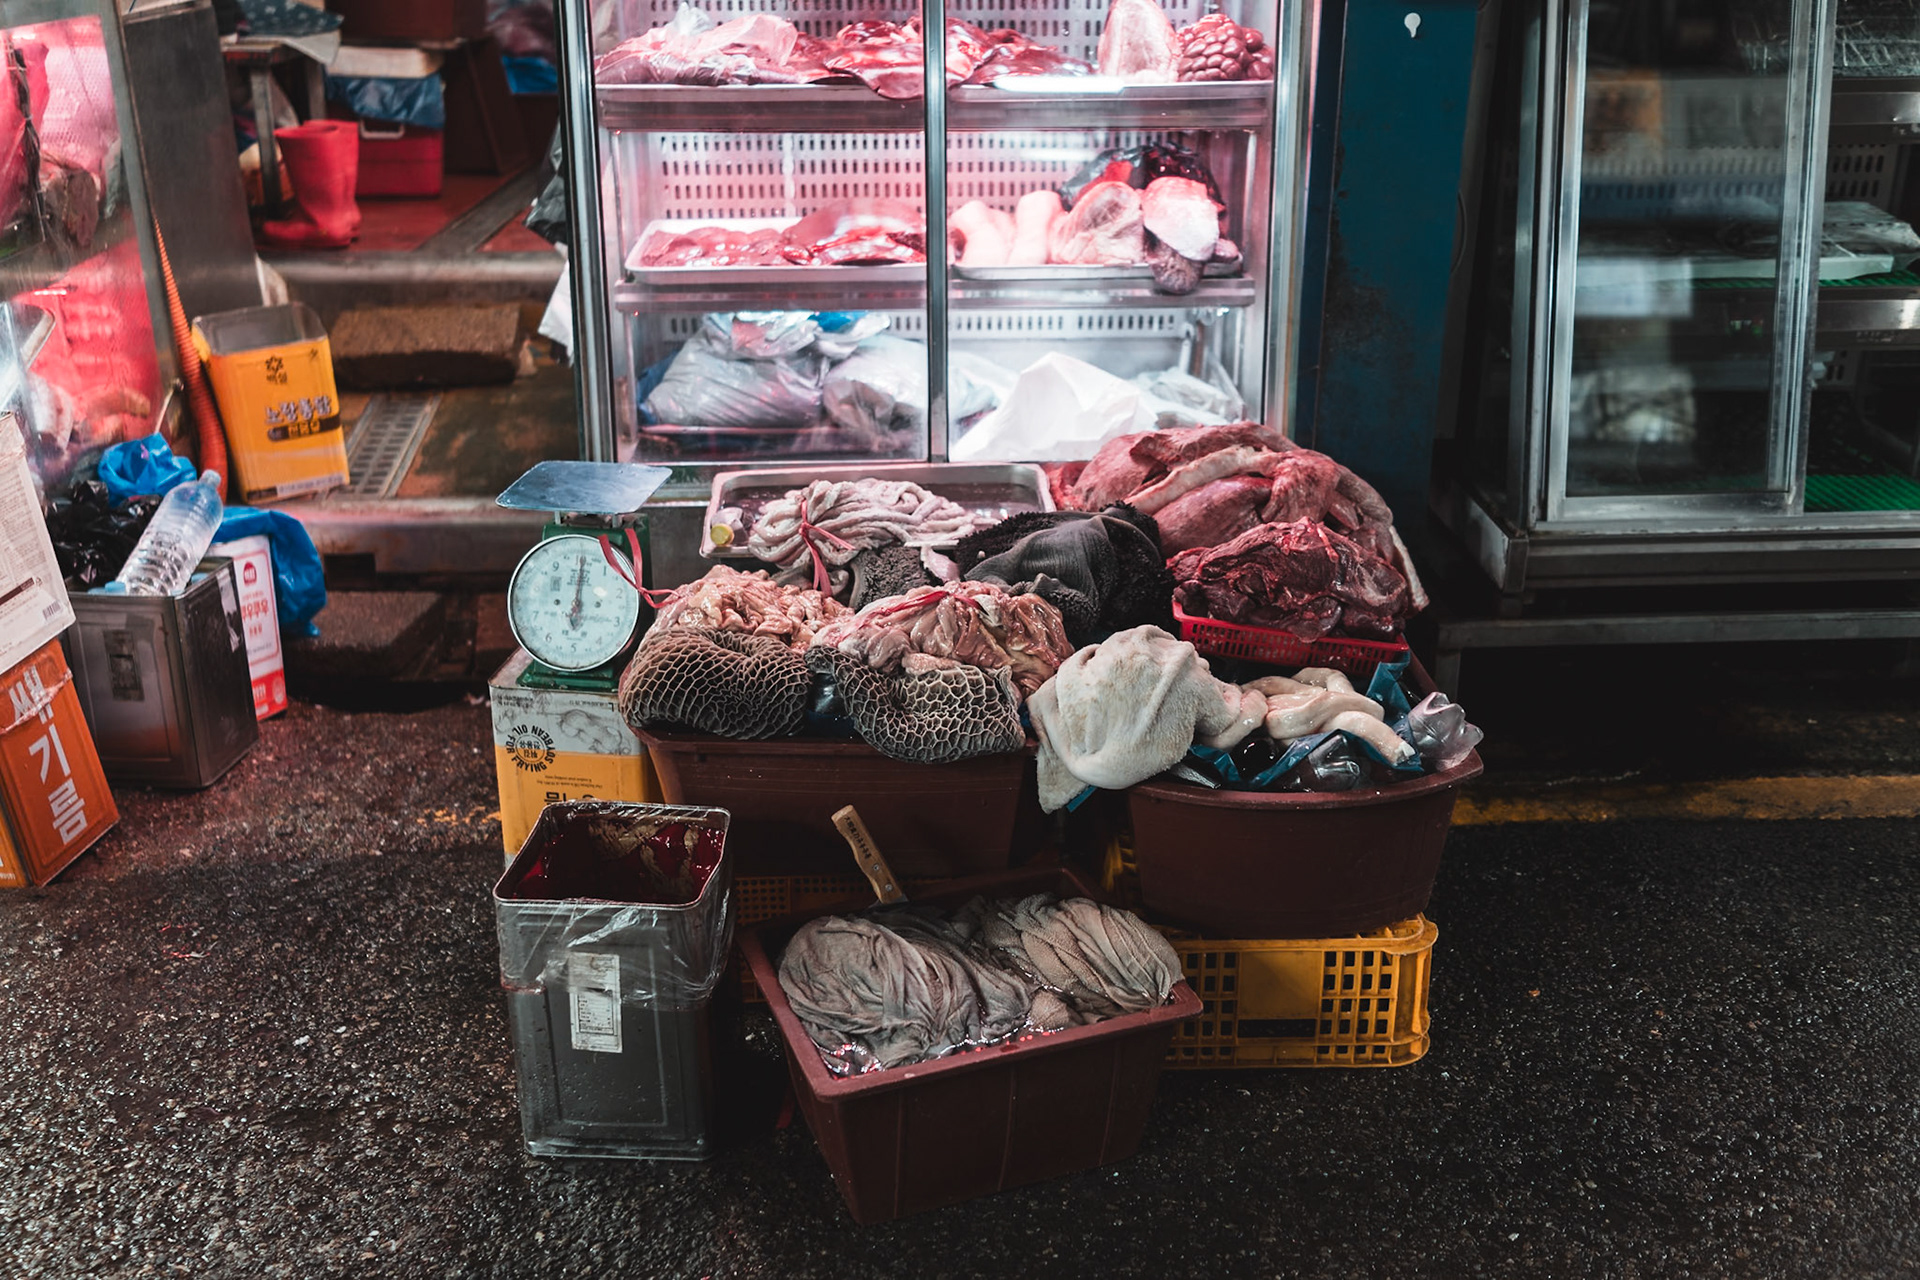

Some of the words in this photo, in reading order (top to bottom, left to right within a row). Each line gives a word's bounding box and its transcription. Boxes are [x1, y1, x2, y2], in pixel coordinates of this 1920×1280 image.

[511, 724, 528, 736] OIL
[505, 734, 516, 754] FOR
[532, 726, 555, 764] SOYBEAN
[511, 754, 547, 773] FRYING
